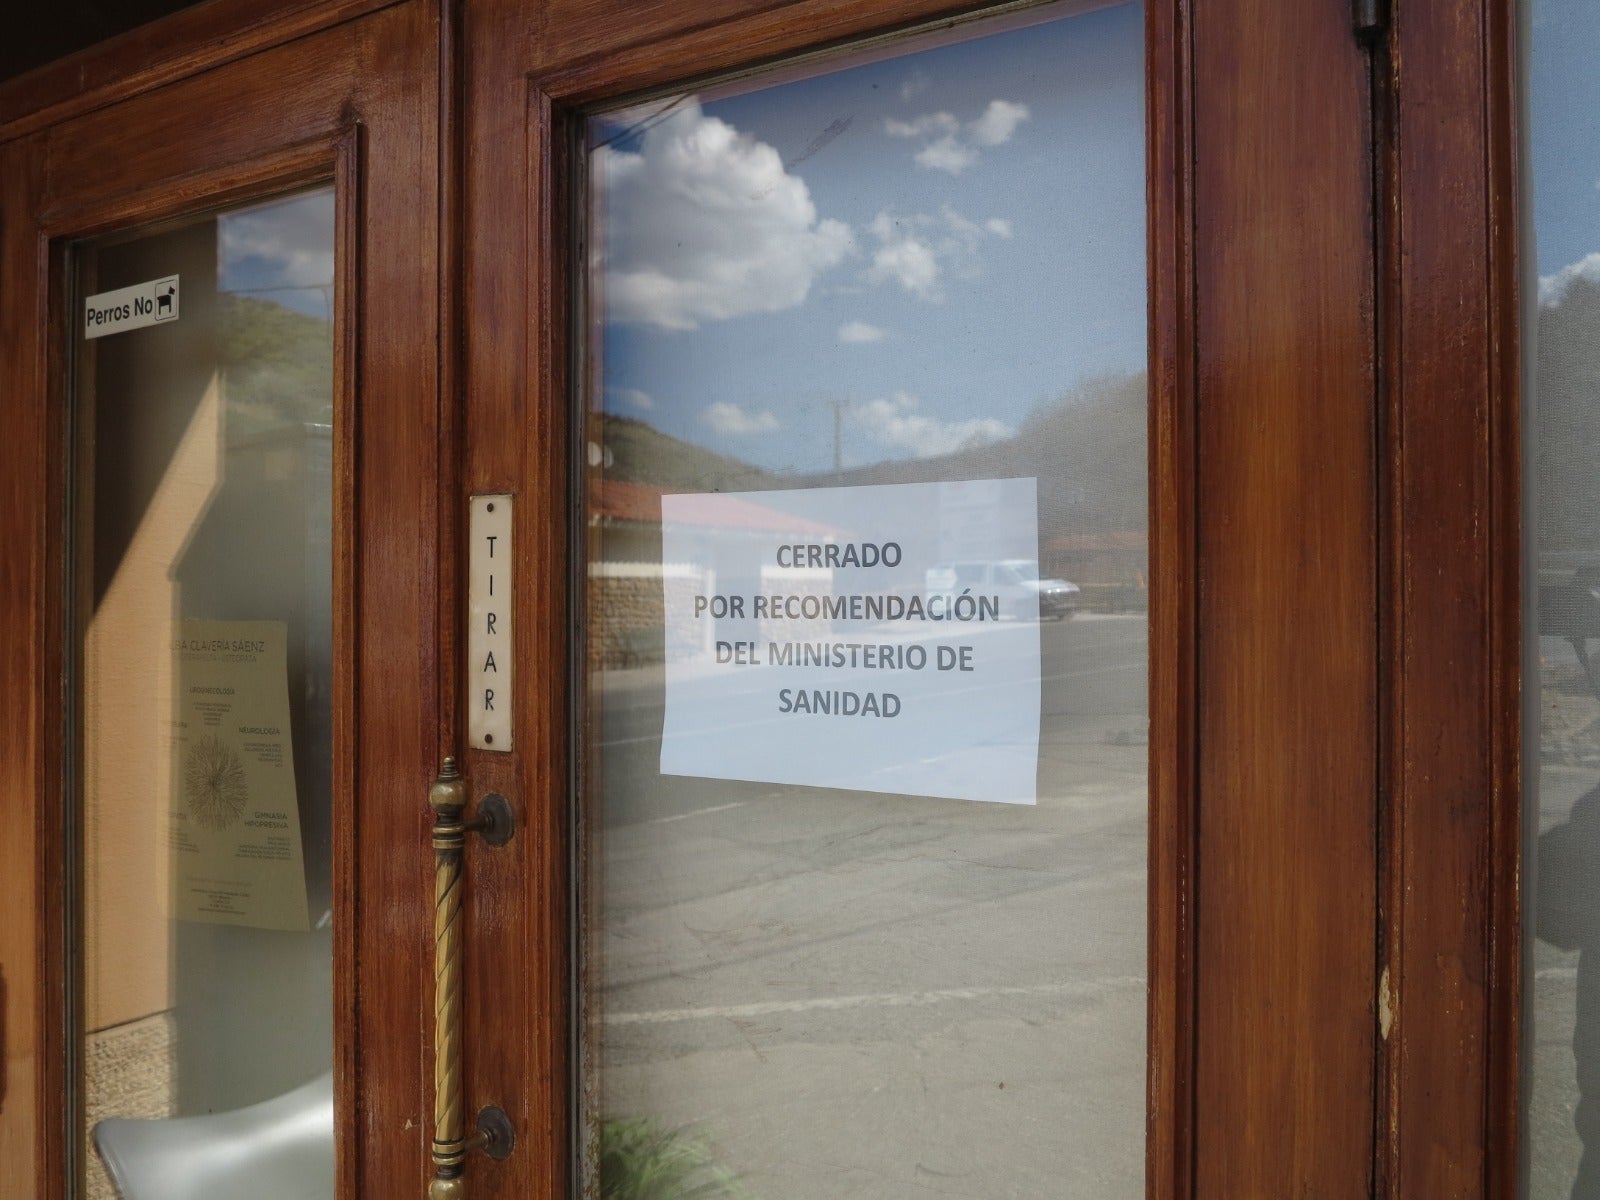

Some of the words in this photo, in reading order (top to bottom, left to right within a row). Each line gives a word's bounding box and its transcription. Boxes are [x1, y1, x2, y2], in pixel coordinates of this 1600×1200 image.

[87, 304, 130, 327] Perros
[134, 297, 153, 316] No
[776, 542, 902, 569] CERRADO
[694, 595, 745, 619] POR
[754, 589, 999, 621] RECOMENDACIÓN
[483, 536, 497, 711] TIRAR
[715, 641, 760, 665] DEL
[769, 642, 927, 671] MINISTERIO
[937, 645, 974, 672] DE
[778, 688, 901, 718] SANIDAD
